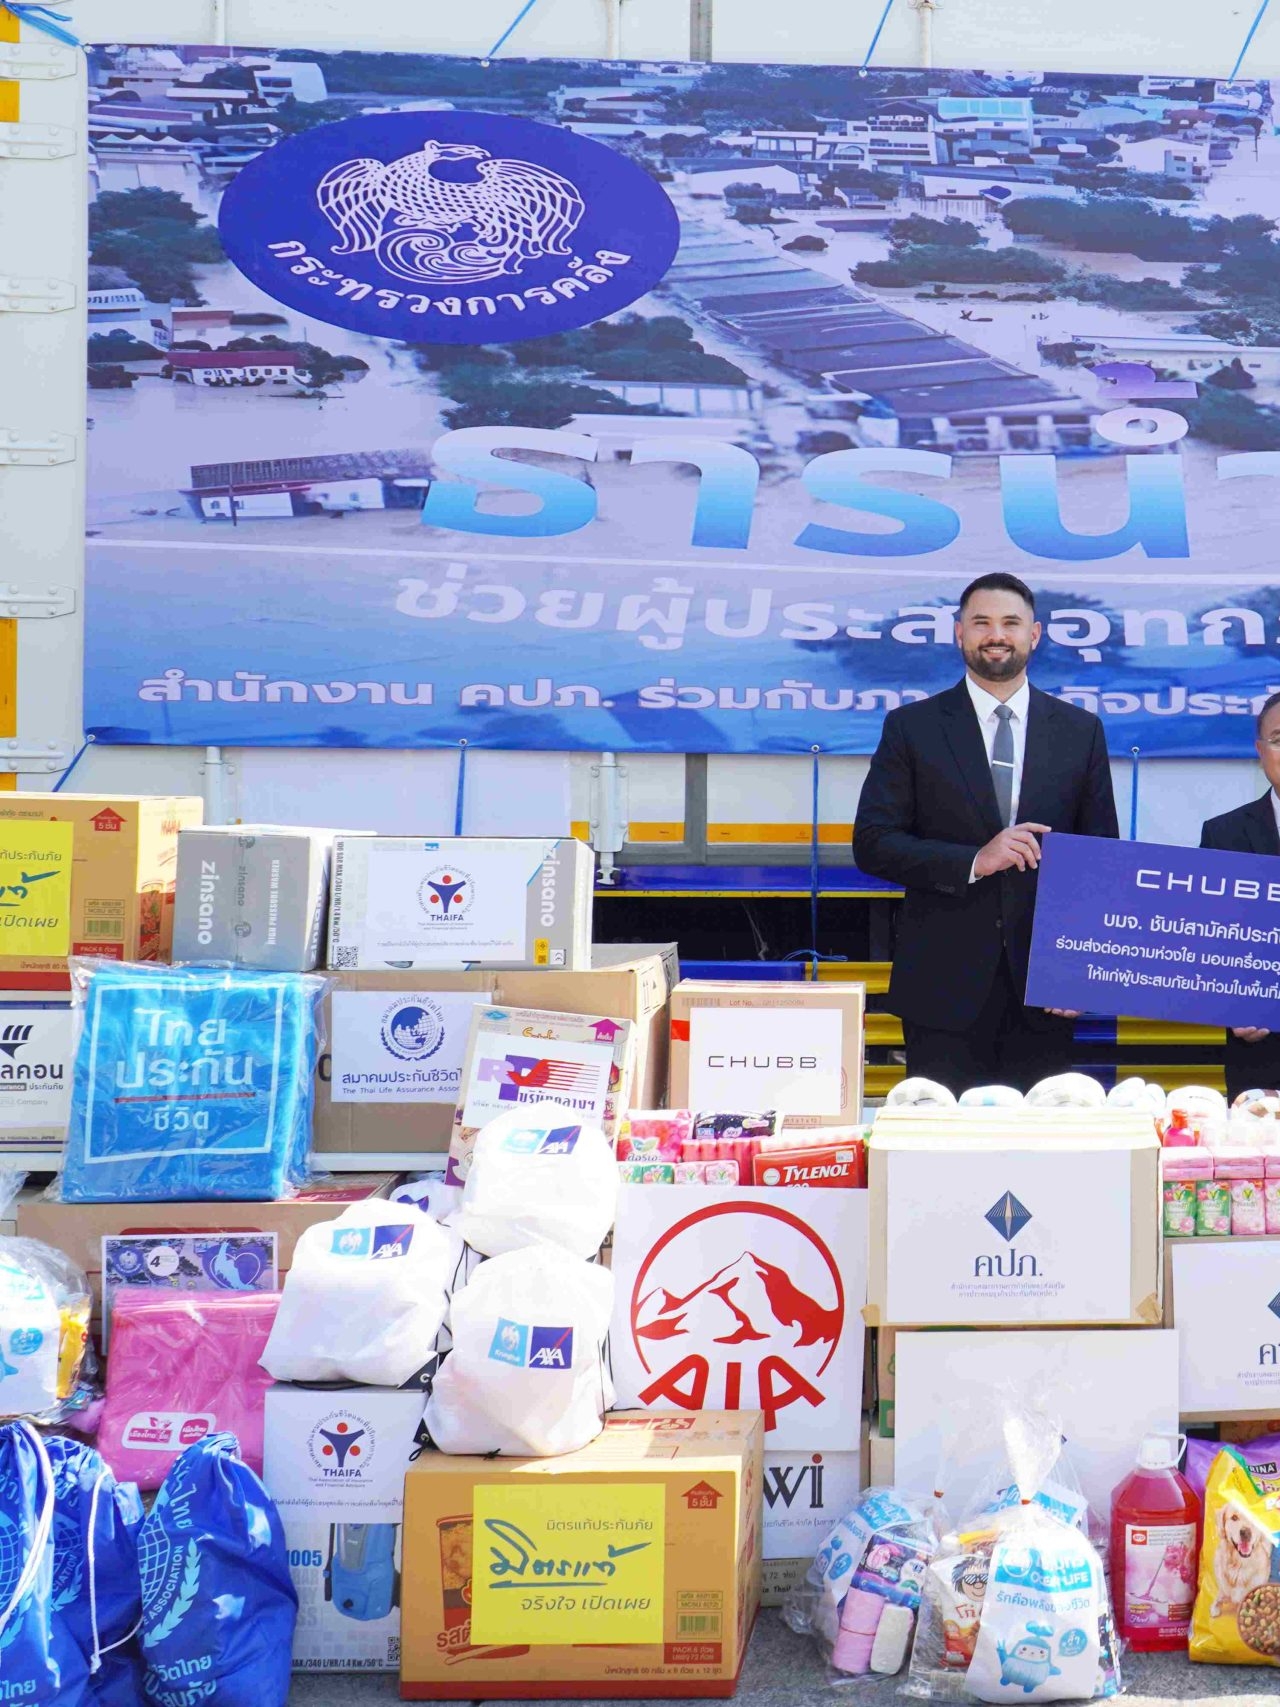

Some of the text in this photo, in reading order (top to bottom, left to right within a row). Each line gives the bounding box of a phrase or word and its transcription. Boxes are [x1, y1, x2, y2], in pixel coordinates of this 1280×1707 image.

[267, 239, 633, 315] กระทรวงการคลัง
[138, 669, 434, 708] สำนักงาน
[459, 678, 613, 709] คปภ.
[198, 861, 217, 945] zinsano
[1103, 912, 1142, 931] บมจ.
[1056, 935, 1197, 964] ร่วมส่งต่อความห่วงใย
[134, 1008, 226, 1047] ไทย
[115, 1050, 254, 1089] ประกัน
[708, 1055, 818, 1068] CHUBB
[152, 1107, 210, 1132] ชีวิต
[783, 1163, 849, 1183] TYLENOL
[371, 1243, 403, 1260] AXA
[973, 1248, 1044, 1278] คปภ.
[529, 1347, 565, 1367] AXA
[637, 1354, 827, 1432] AIA
[323, 1468, 362, 1478] THAIFA
[1248, 1463, 1278, 1475] RINA
[546, 1519, 654, 1532] มิตรแท้ประกันภัย
[149, 1545, 185, 1624] ASSOCIATION
[521, 1595, 651, 1611] จริงใจ เปิดเผย
